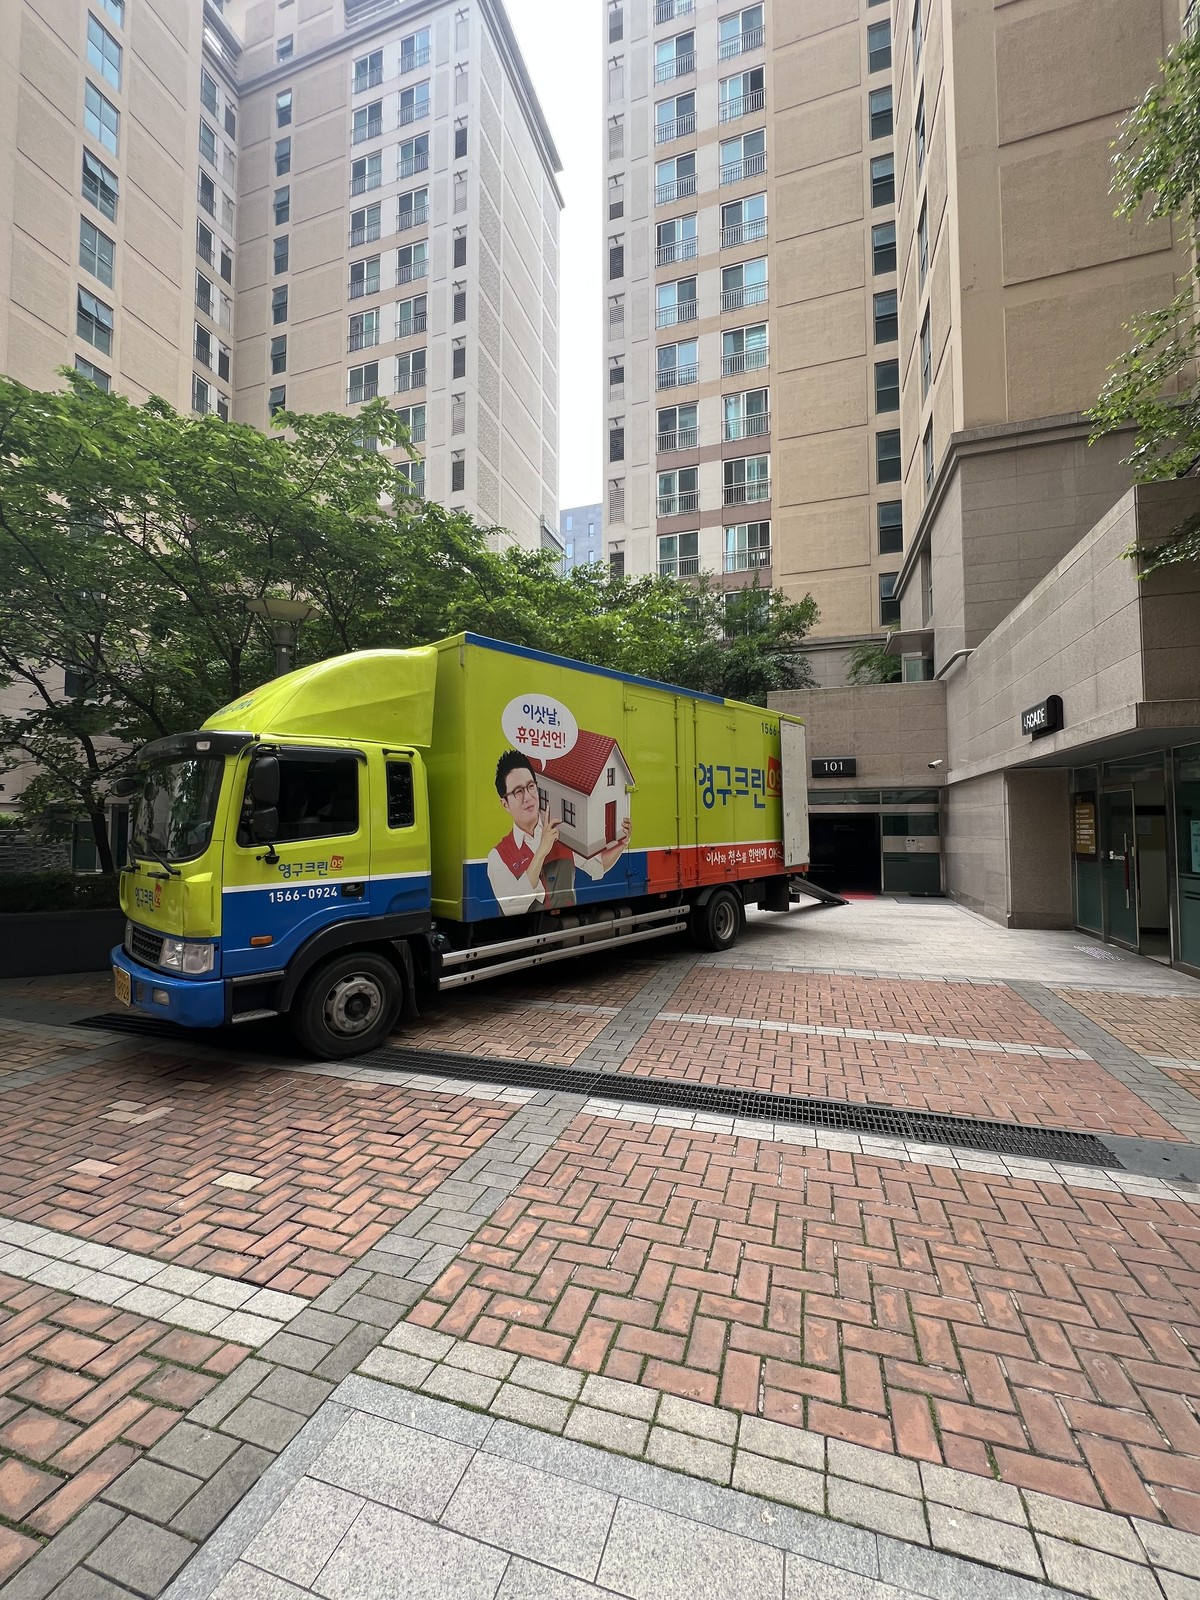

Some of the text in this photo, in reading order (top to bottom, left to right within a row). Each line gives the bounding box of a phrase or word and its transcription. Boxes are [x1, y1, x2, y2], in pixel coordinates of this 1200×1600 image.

[522, 704, 561, 727] 이삿날,
[515, 726, 566, 749] 휴일선언!
[823, 761, 844, 772] 101
[694, 762, 766, 809] 영구크린
[278, 861, 328, 879] 영구크린
[269, 886, 338, 903] 1566-0924
